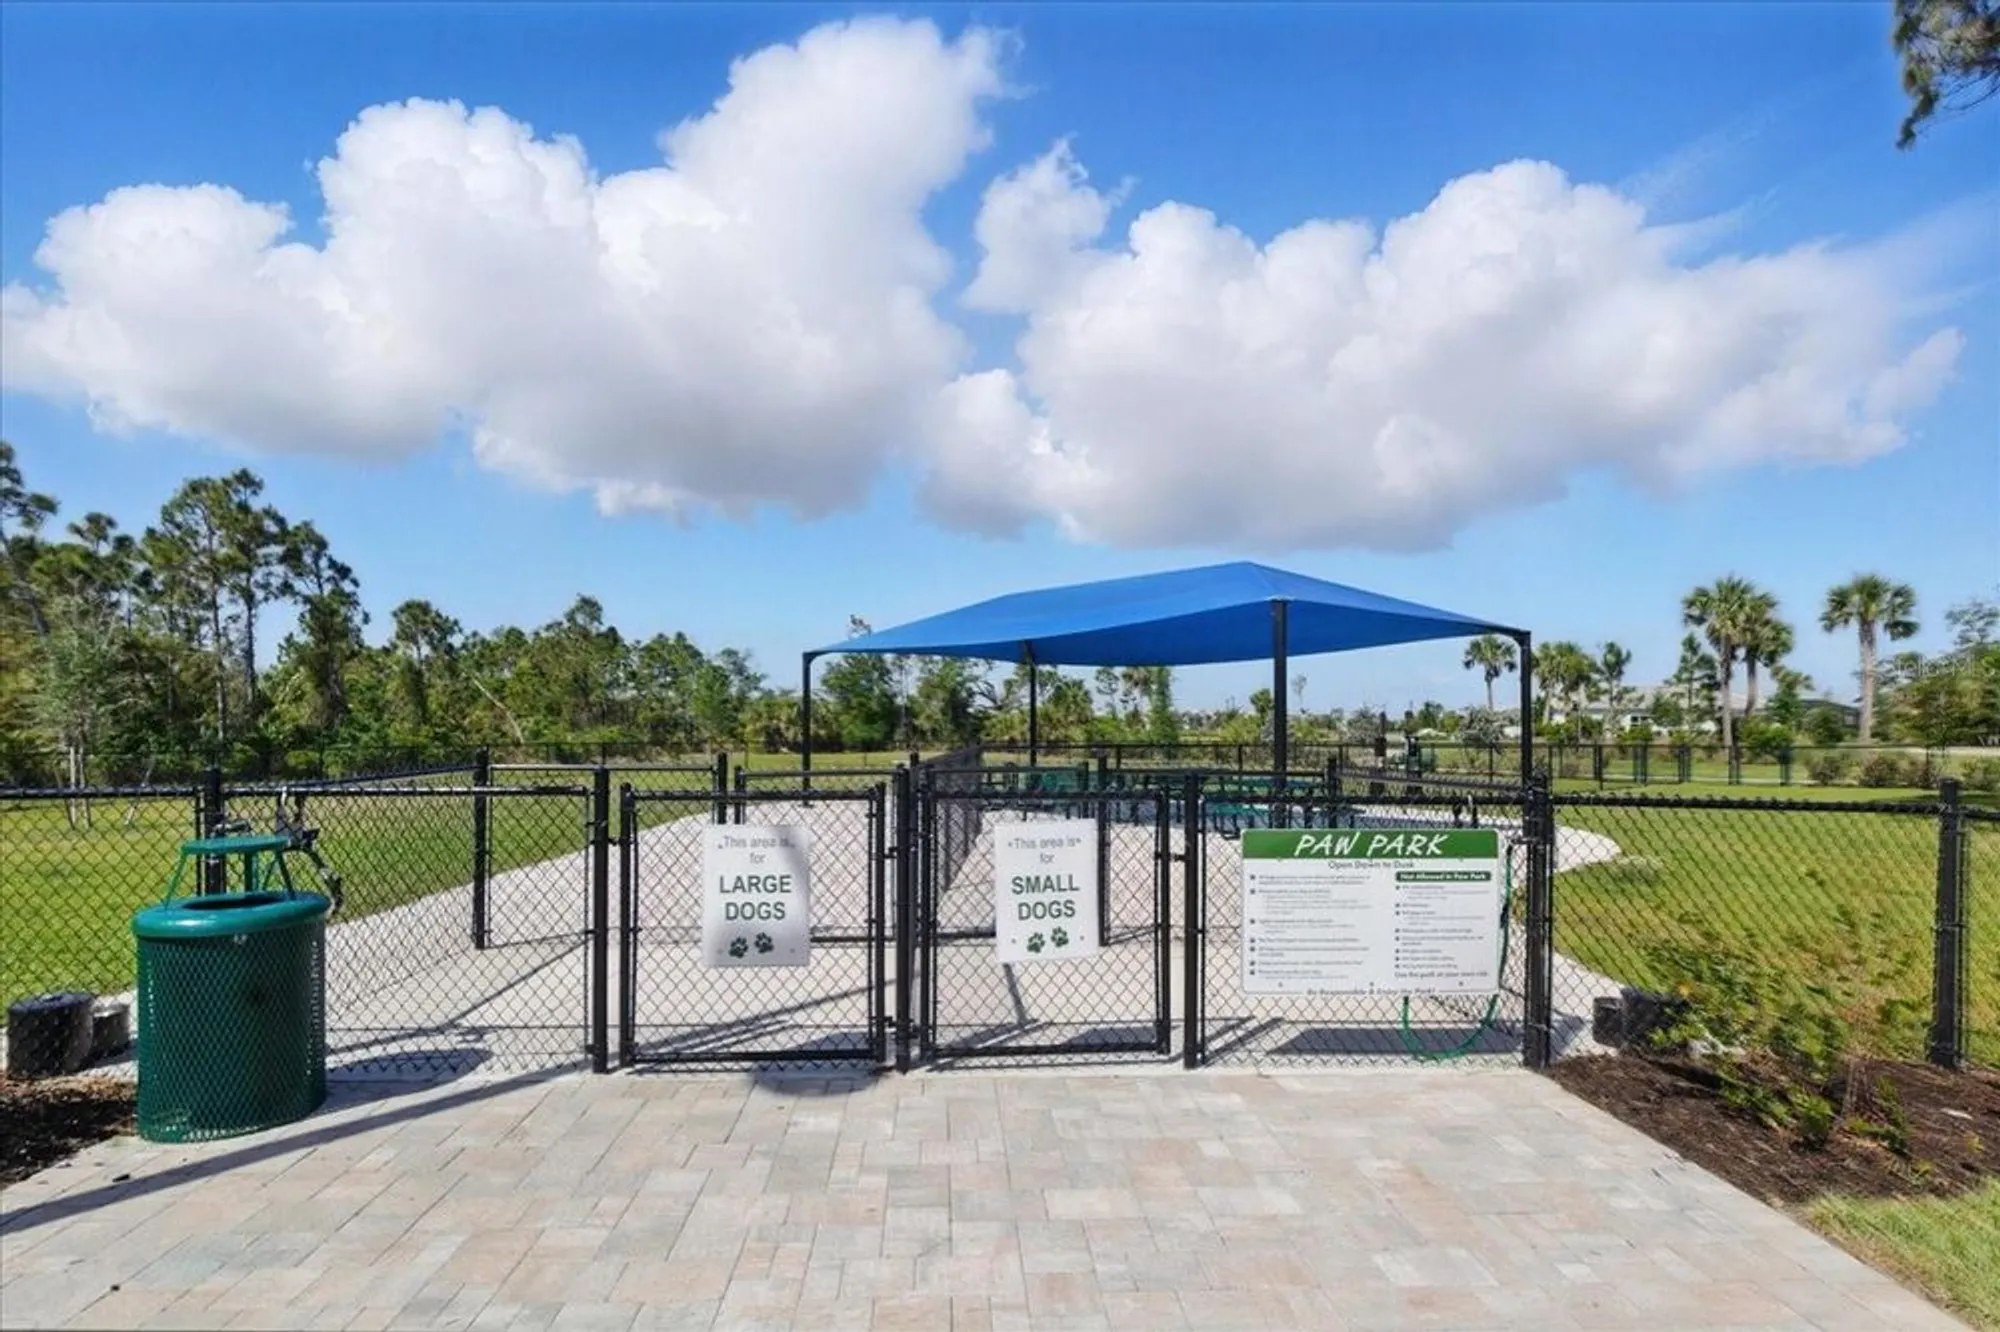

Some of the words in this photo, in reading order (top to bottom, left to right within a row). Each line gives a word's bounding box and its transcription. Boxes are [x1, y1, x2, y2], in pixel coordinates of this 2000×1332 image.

[723, 835, 747, 848] This
[750, 837, 777, 848] area
[1013, 837, 1036, 849] This
[1040, 838, 1064, 849] area
[1066, 837, 1076, 847] is
[1293, 831, 1361, 857] PAW
[1366, 832, 1449, 857] PARK
[749, 851, 766, 864] for
[1040, 852, 1055, 864] for
[1328, 860, 1353, 871] Open
[1382, 861, 1391, 869] to
[1394, 860, 1414, 869] Dusk
[719, 874, 792, 893] LARGE
[1011, 873, 1080, 895] SMALL
[725, 901, 785, 920] DOGS
[1018, 899, 1076, 921] DOGS
